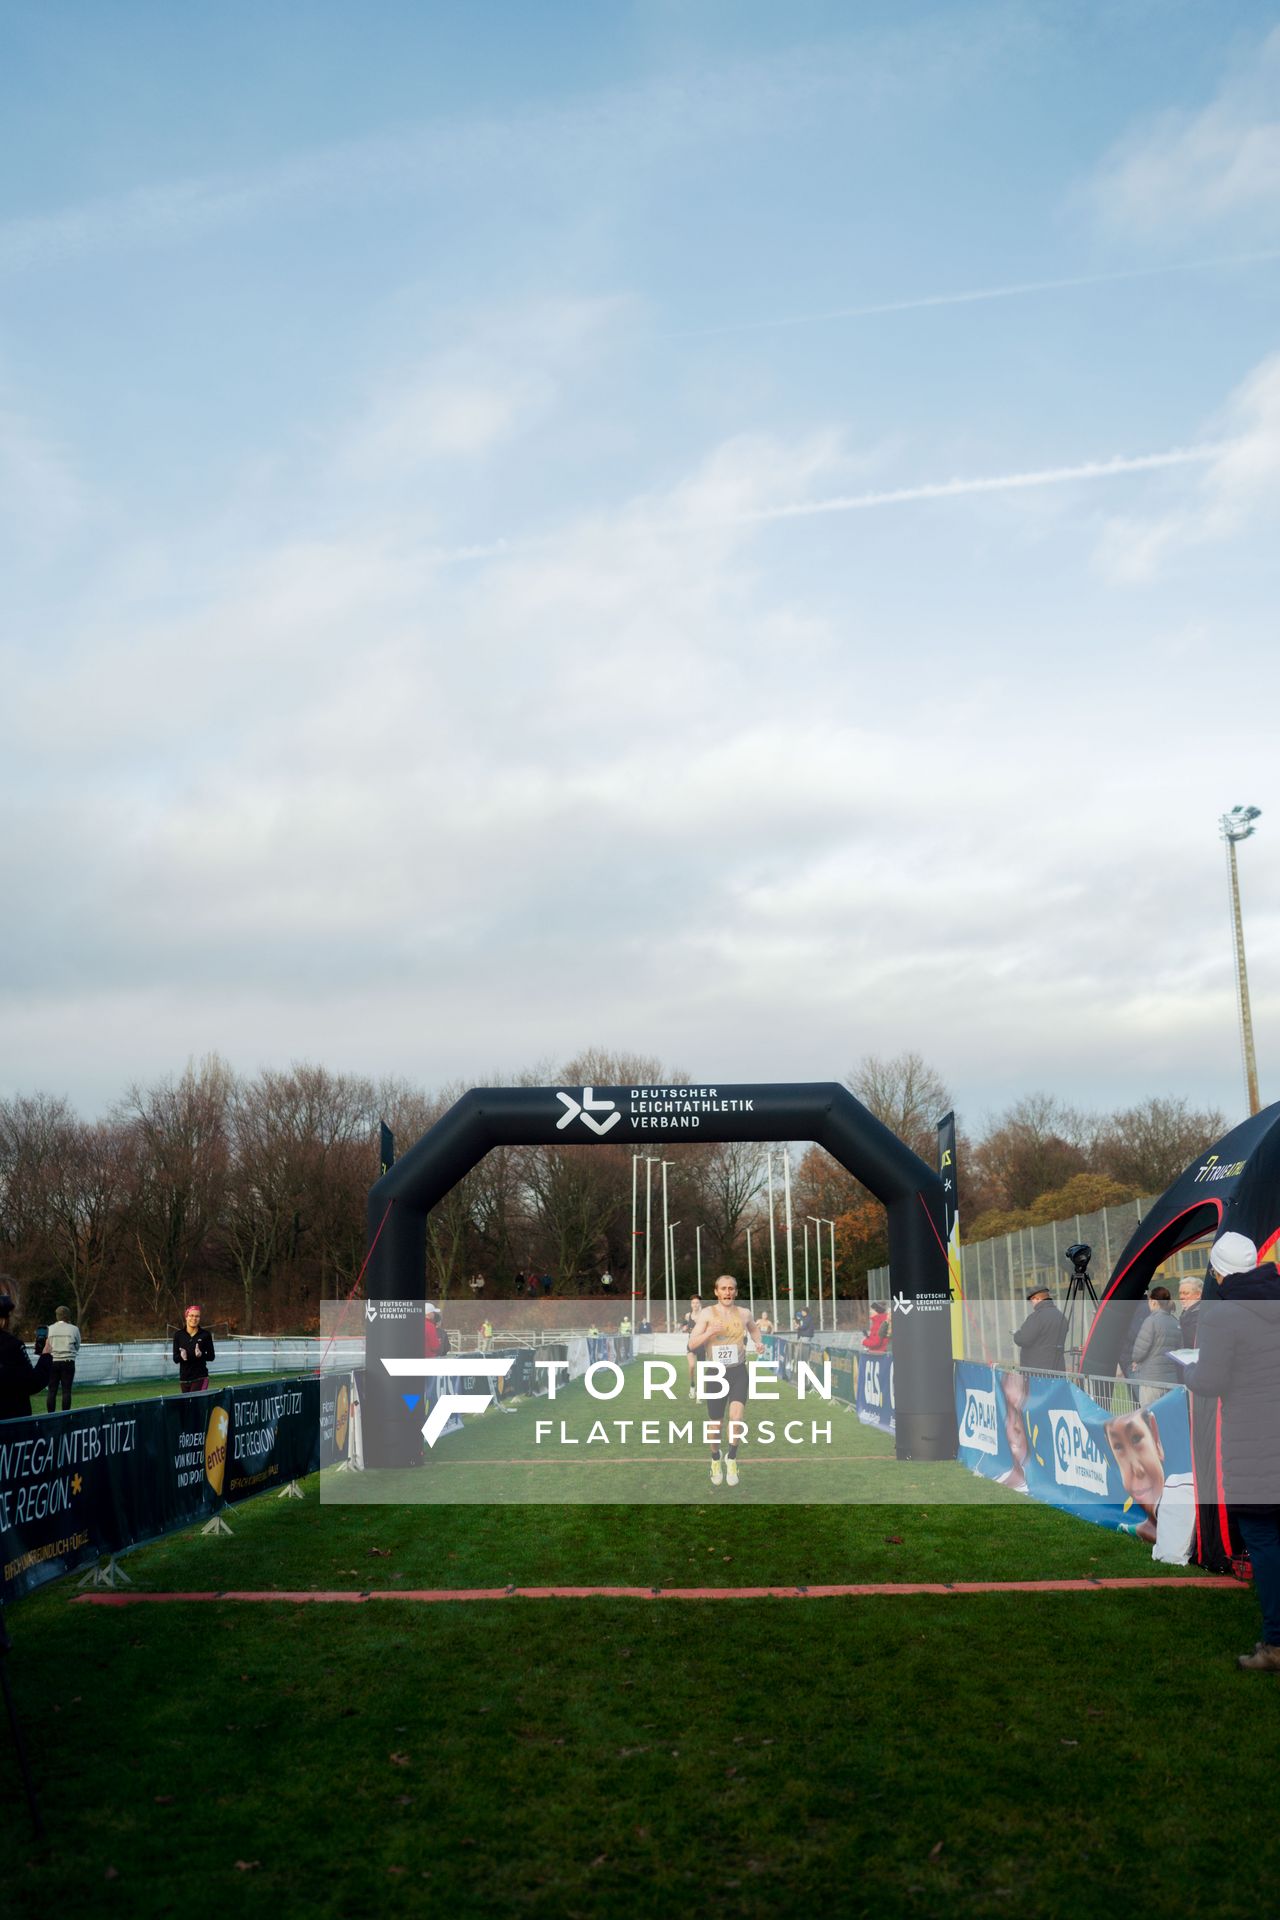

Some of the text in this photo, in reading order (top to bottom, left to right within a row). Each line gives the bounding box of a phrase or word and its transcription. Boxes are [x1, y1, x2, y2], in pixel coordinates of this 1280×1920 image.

[631, 1088, 718, 1099] DEUTSCHER
[631, 1100, 754, 1113] LEICHTATHLETIK
[631, 1116, 700, 1128] VERBAND
[717, 1351, 733, 1359] 227
